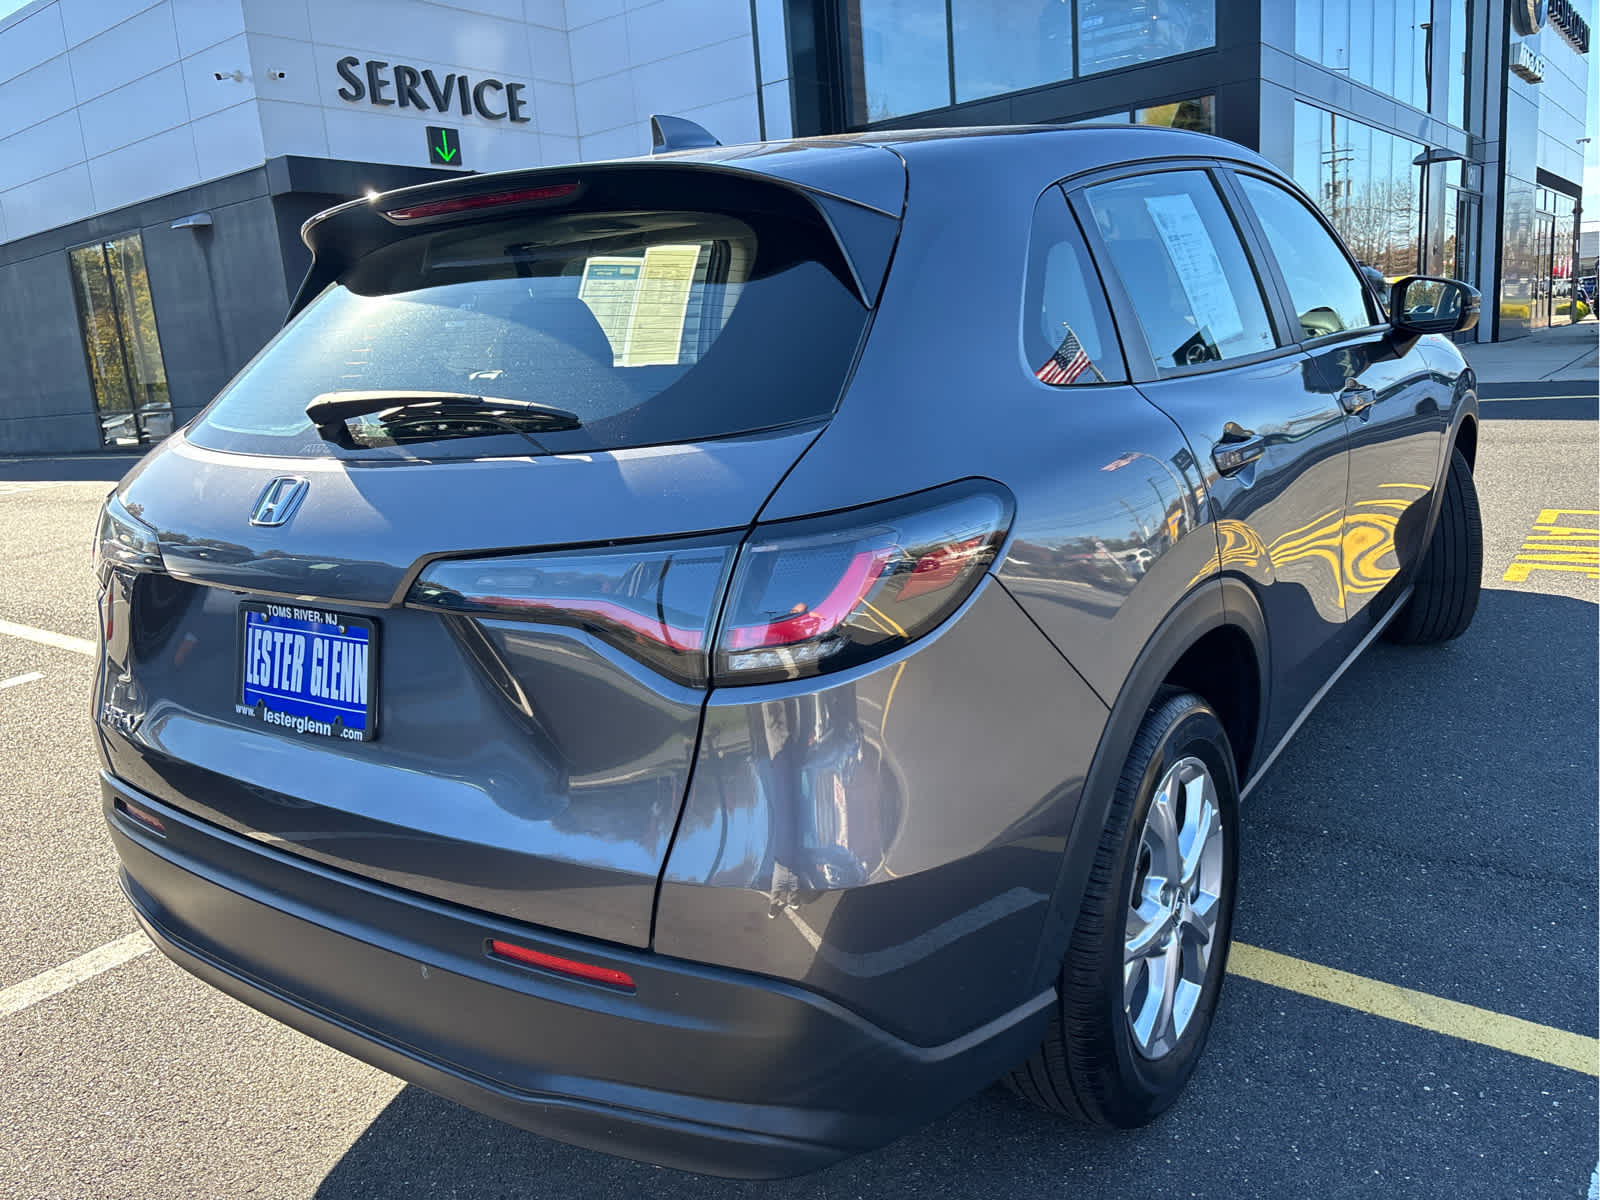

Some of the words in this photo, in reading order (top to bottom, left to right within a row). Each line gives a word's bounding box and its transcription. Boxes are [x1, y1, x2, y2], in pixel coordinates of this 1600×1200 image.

[336, 55, 531, 123] SERVICE
[267, 604, 292, 619] TOMS
[293, 607, 323, 623] RIVER,
[325, 612, 338, 625] NJ
[246, 627, 306, 693] LESTER
[310, 637, 369, 705] GLENN
[235, 704, 256, 717] www.
[263, 707, 332, 736] lesterglenn
[340, 728, 363, 741] .com
